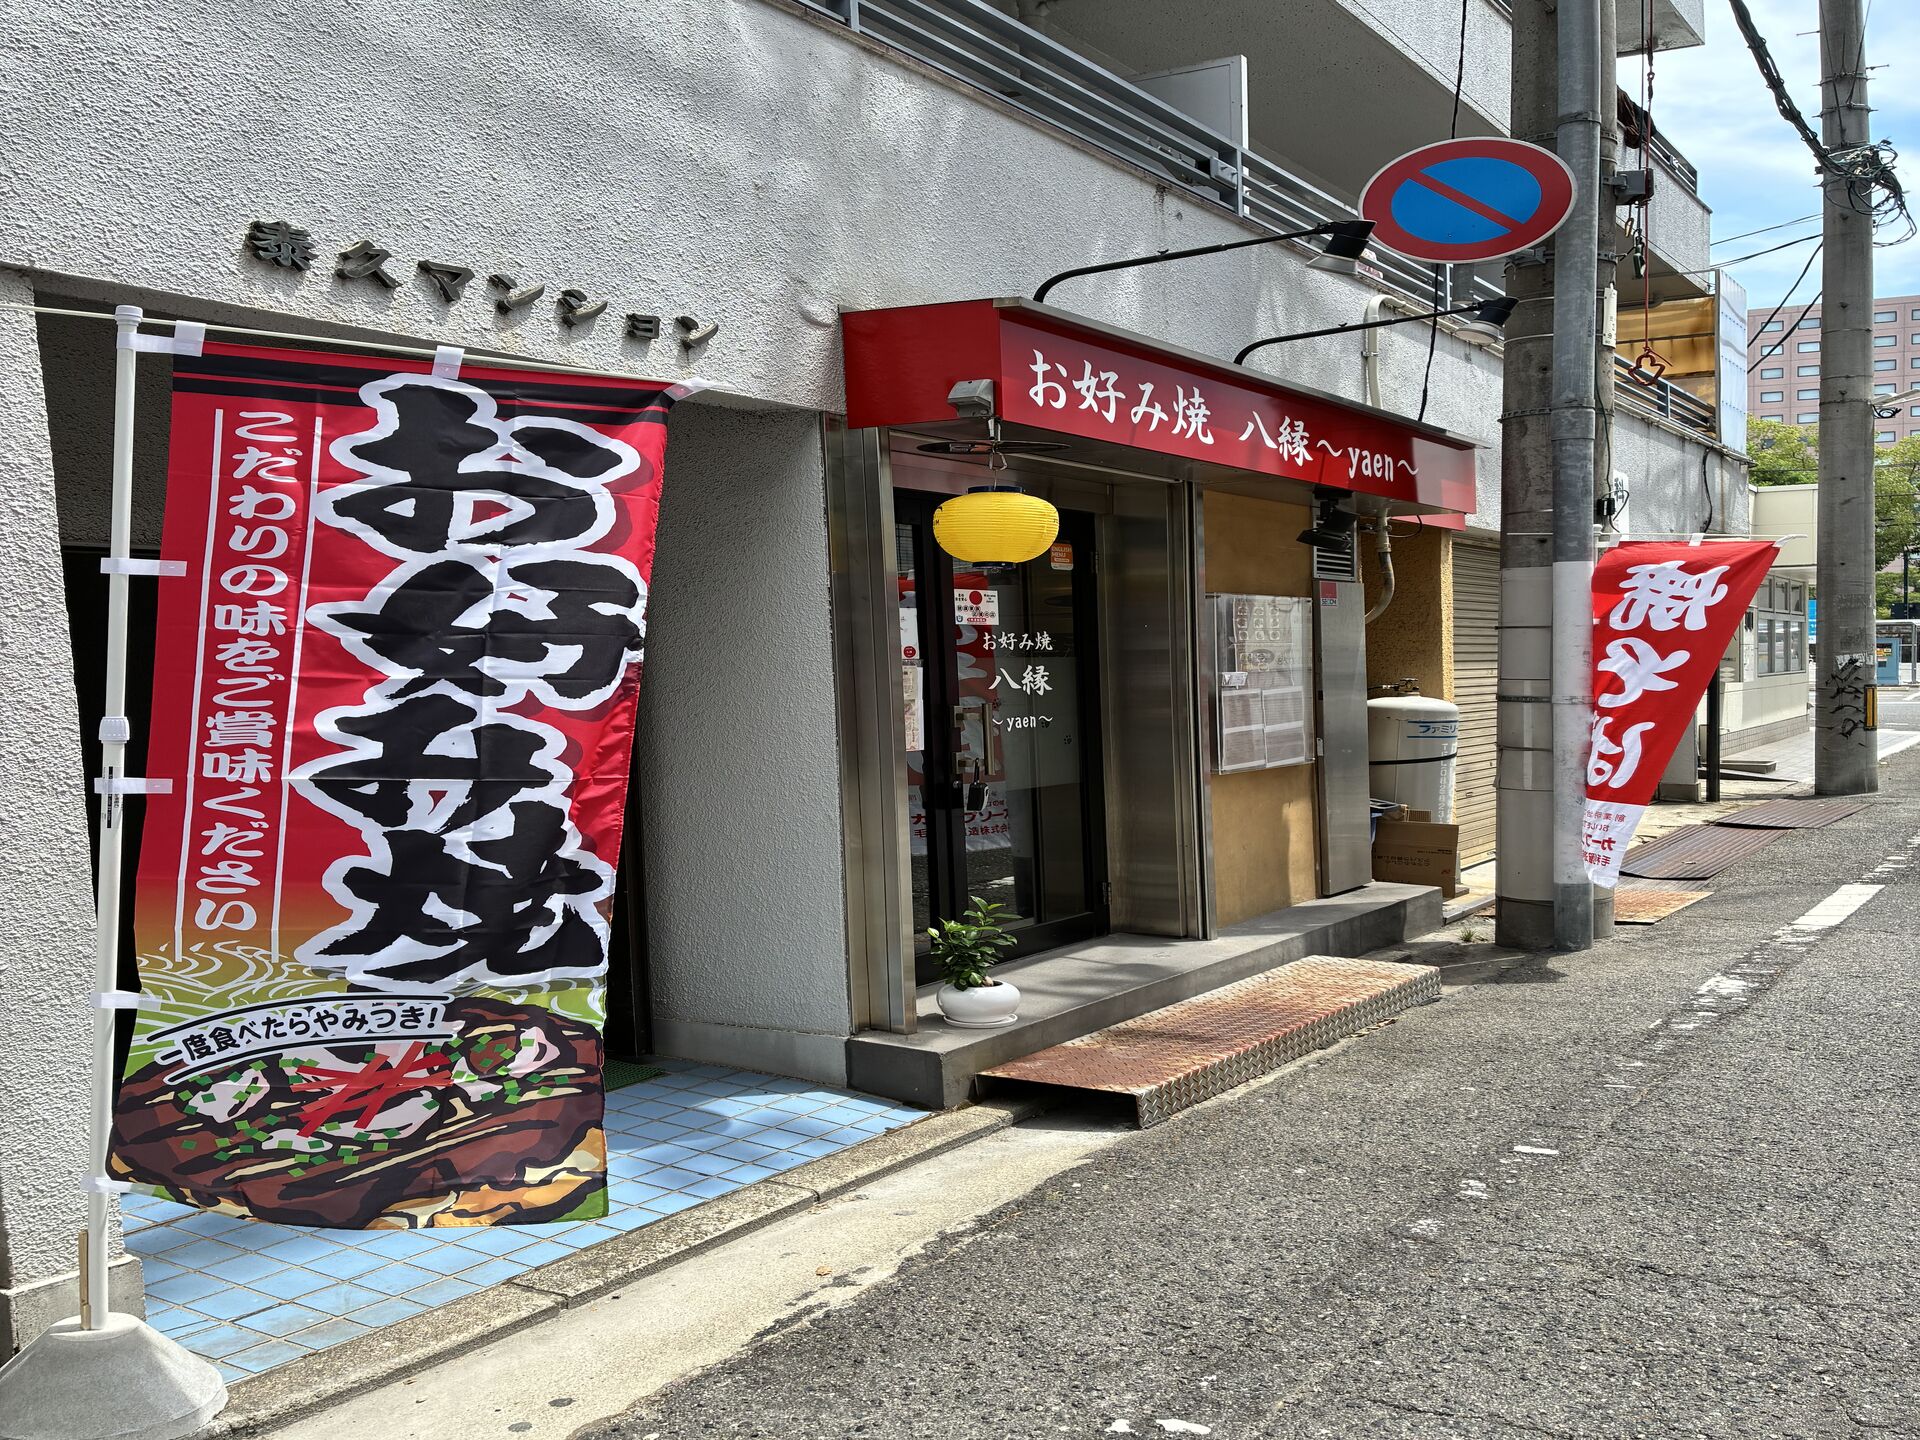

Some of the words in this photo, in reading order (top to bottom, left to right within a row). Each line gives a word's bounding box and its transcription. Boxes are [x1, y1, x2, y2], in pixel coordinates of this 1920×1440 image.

[245, 220, 720, 350] 泰久マンション
[1028, 348, 1215, 446] お好み焼
[194, 410, 303, 932] こだわりの味をご賞味ください
[305, 378, 648, 982] お好み焼
[983, 631, 1053, 651] お好み焼
[988, 664, 1053, 696] 八縁
[1418, 724, 1458, 734] ファミリ
